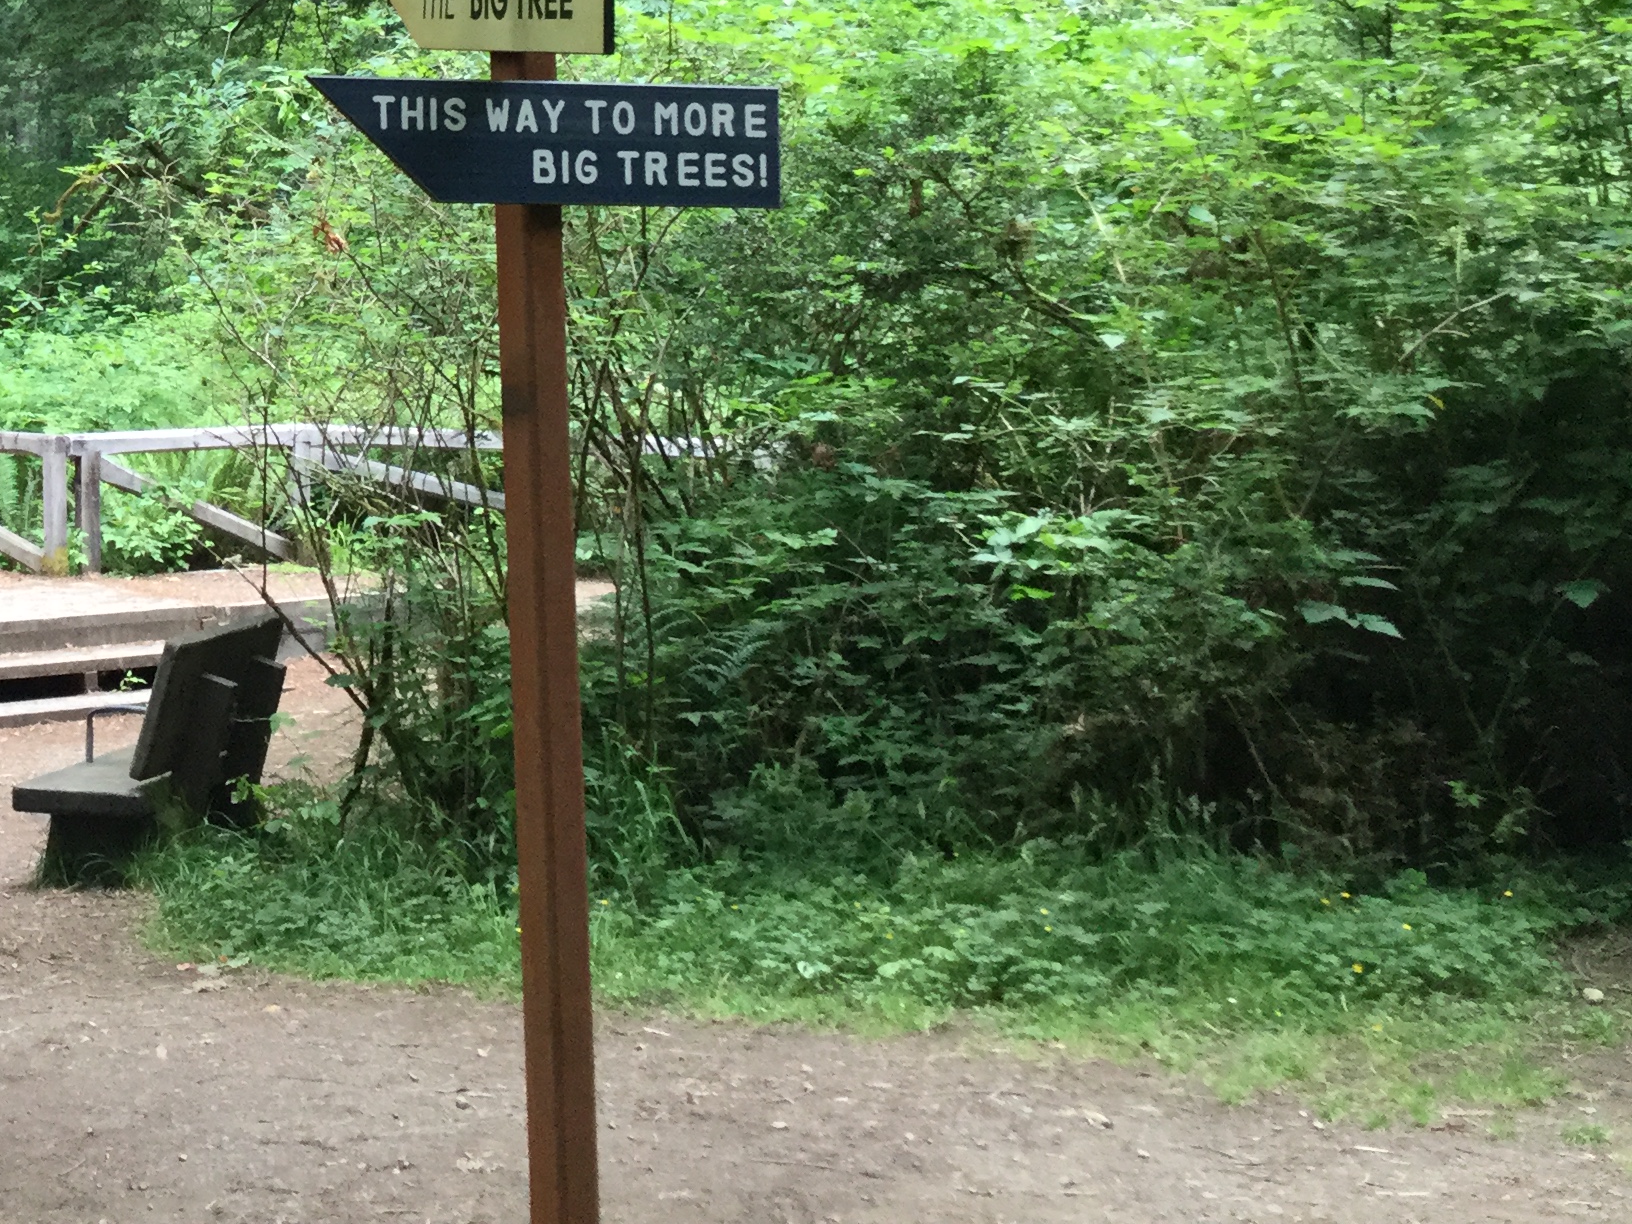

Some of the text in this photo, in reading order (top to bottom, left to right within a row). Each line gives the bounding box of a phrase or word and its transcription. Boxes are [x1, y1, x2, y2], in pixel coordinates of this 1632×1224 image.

[371, 94, 768, 139] THIS WAY TO MORE
[531, 148, 768, 188] BIG TREES!
